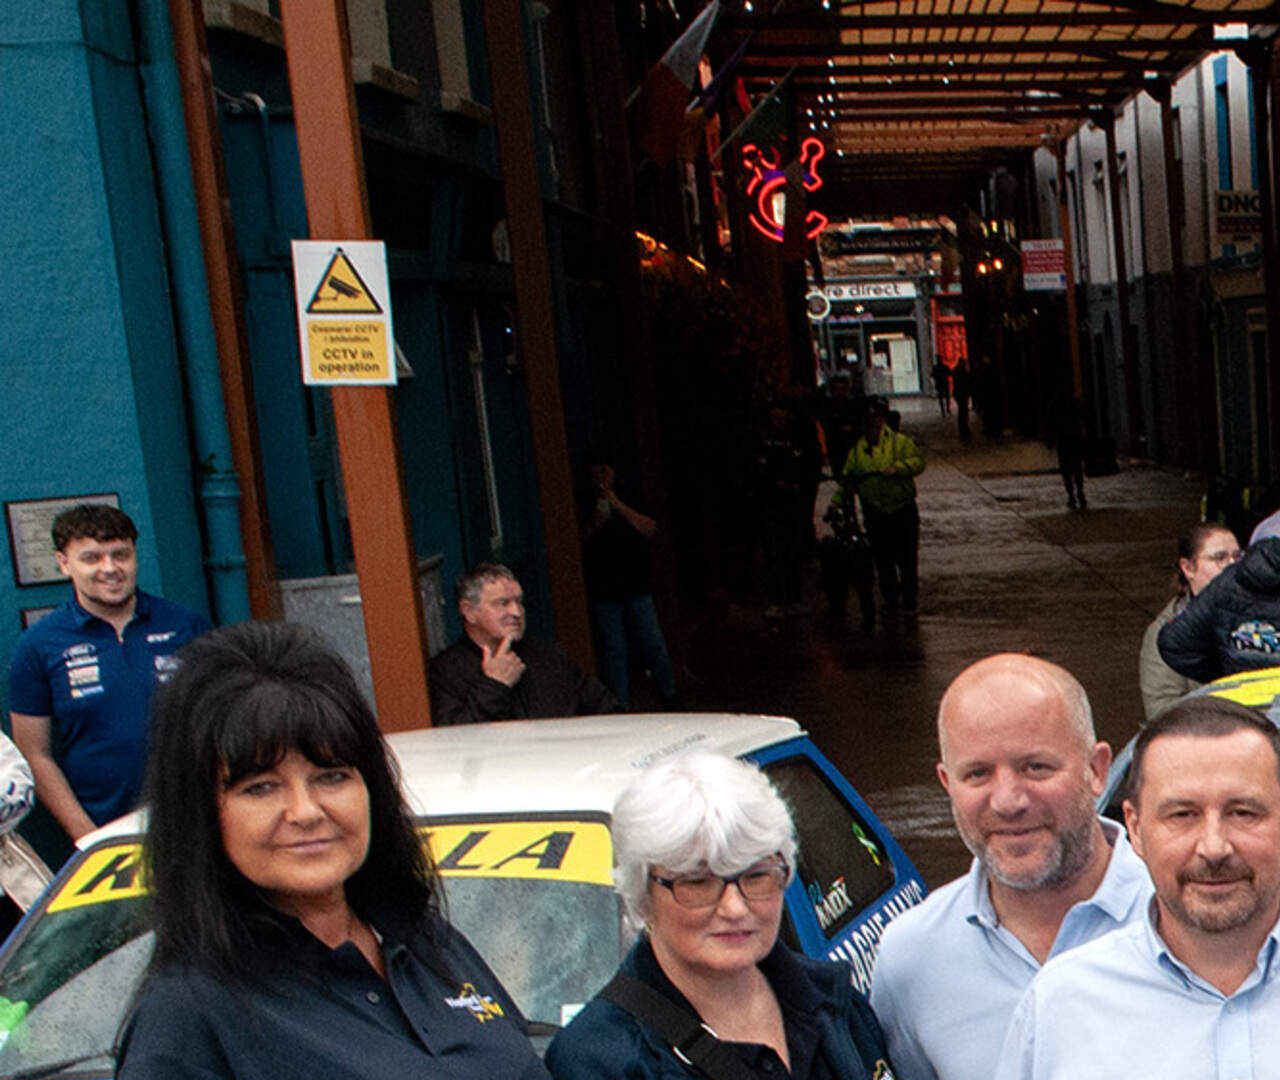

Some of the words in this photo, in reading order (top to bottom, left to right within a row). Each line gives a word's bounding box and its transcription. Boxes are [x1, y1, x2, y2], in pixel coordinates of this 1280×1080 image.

[849, 283, 901, 297] direct
[322, 348, 358, 359] CCTV
[361, 348, 374, 359] in
[318, 363, 380, 375] operation
